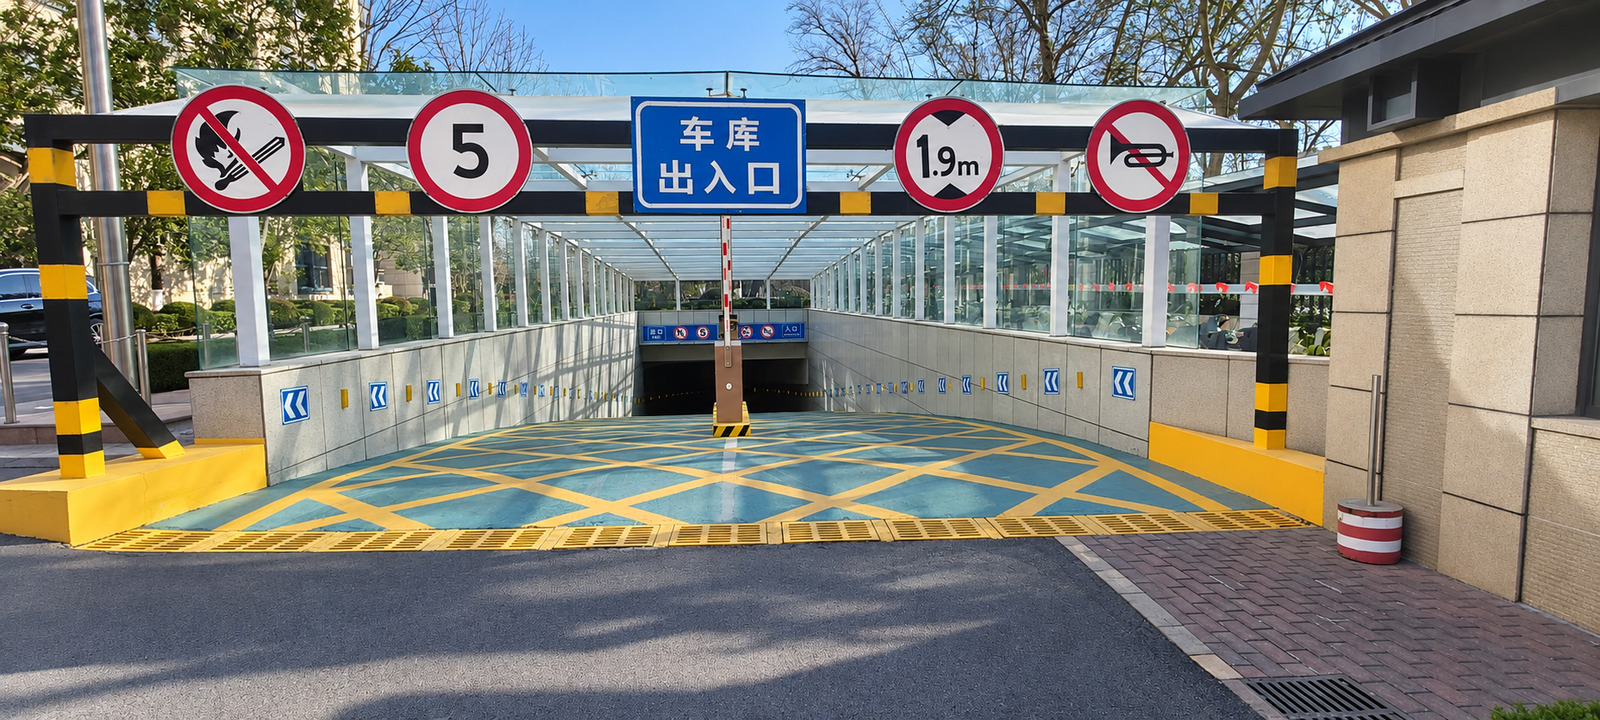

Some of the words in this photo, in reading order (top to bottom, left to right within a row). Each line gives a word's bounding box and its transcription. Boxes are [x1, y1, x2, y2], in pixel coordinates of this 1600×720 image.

[453, 123, 489, 179] 5
[680, 116, 760, 151] 车库
[916, 134, 979, 178] 1.9m
[659, 159, 780, 195] 出入口
